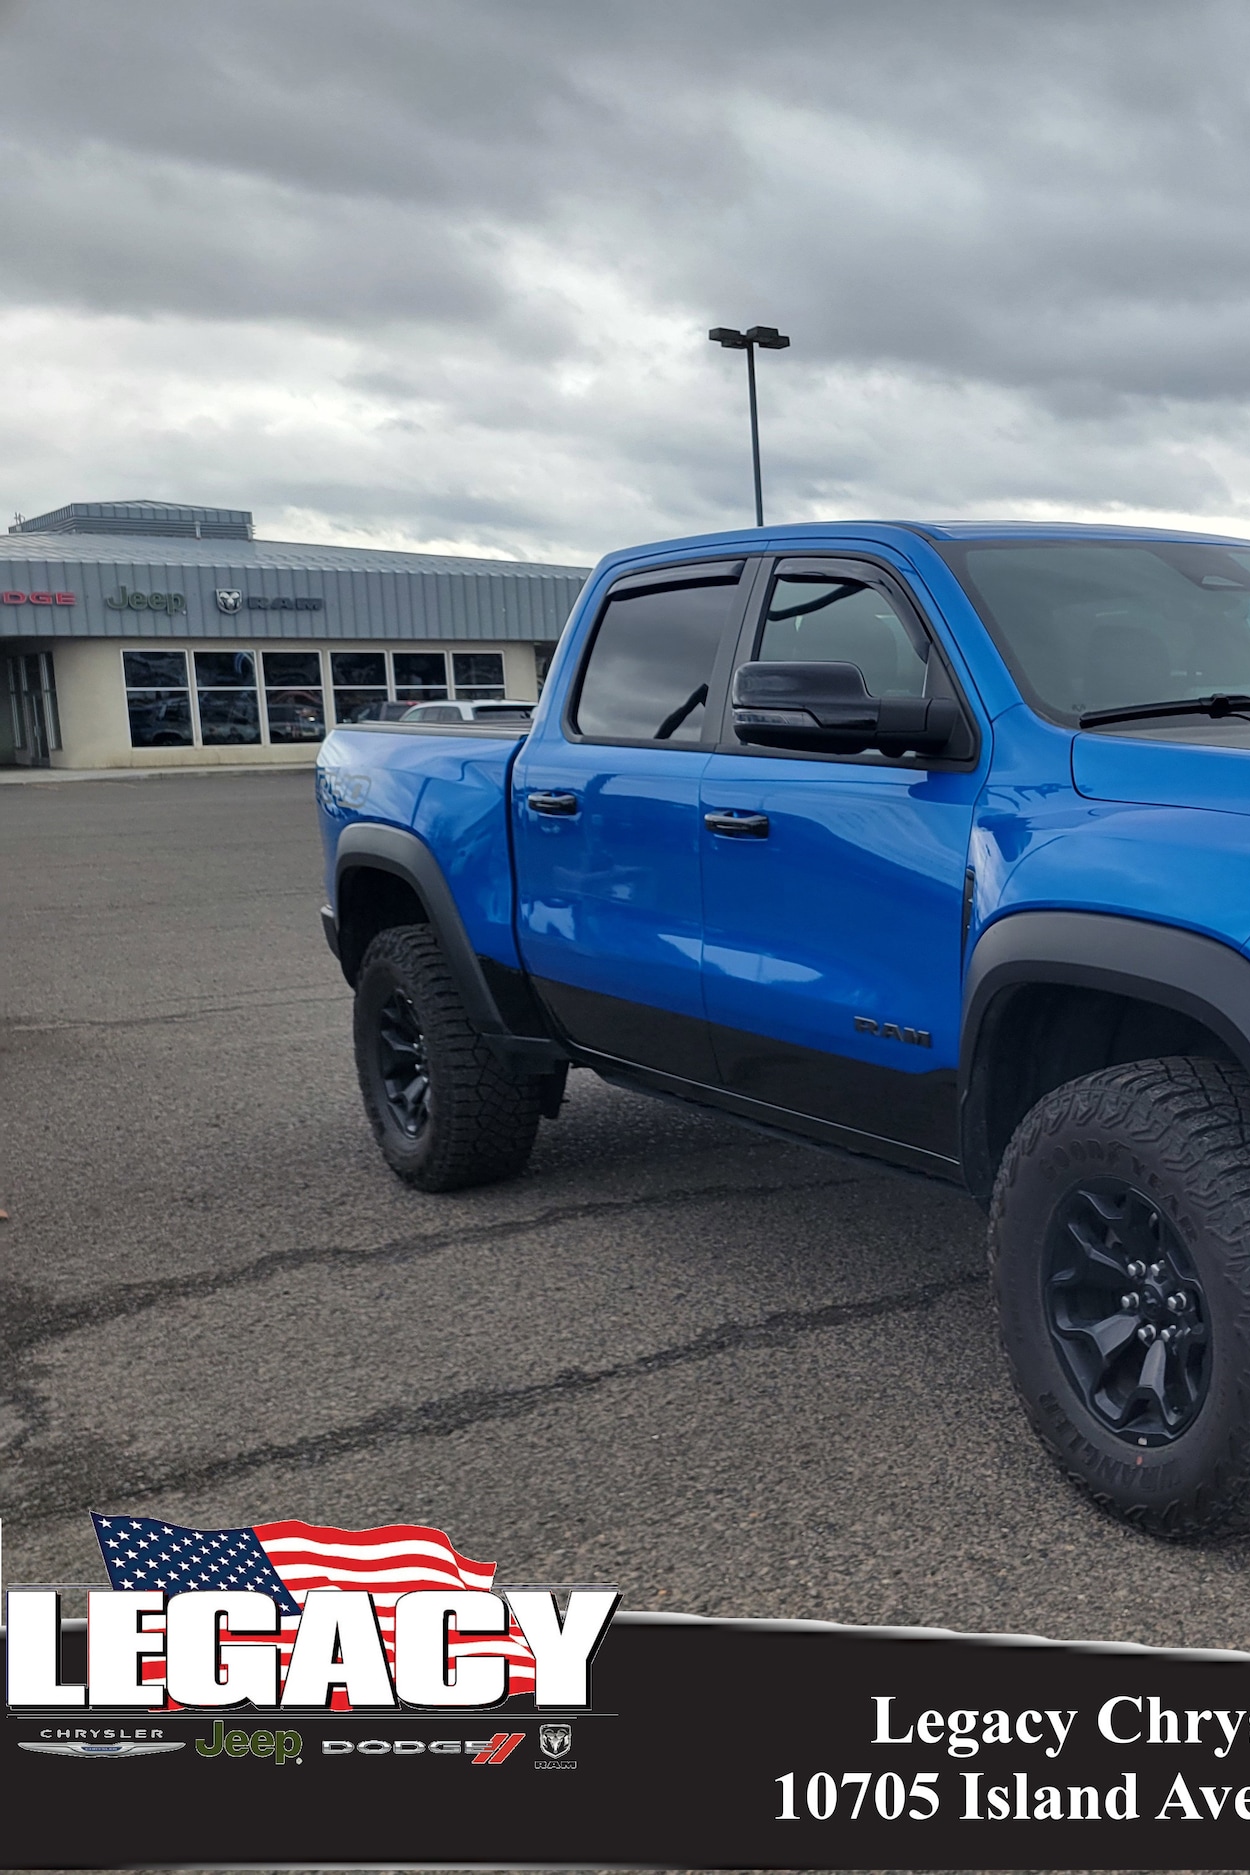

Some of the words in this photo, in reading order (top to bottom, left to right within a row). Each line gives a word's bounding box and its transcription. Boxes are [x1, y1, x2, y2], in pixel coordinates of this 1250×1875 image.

[107, 586, 187, 616] Jeep
[247, 596, 324, 611] RAM
[854, 1015, 932, 1049] RAM
